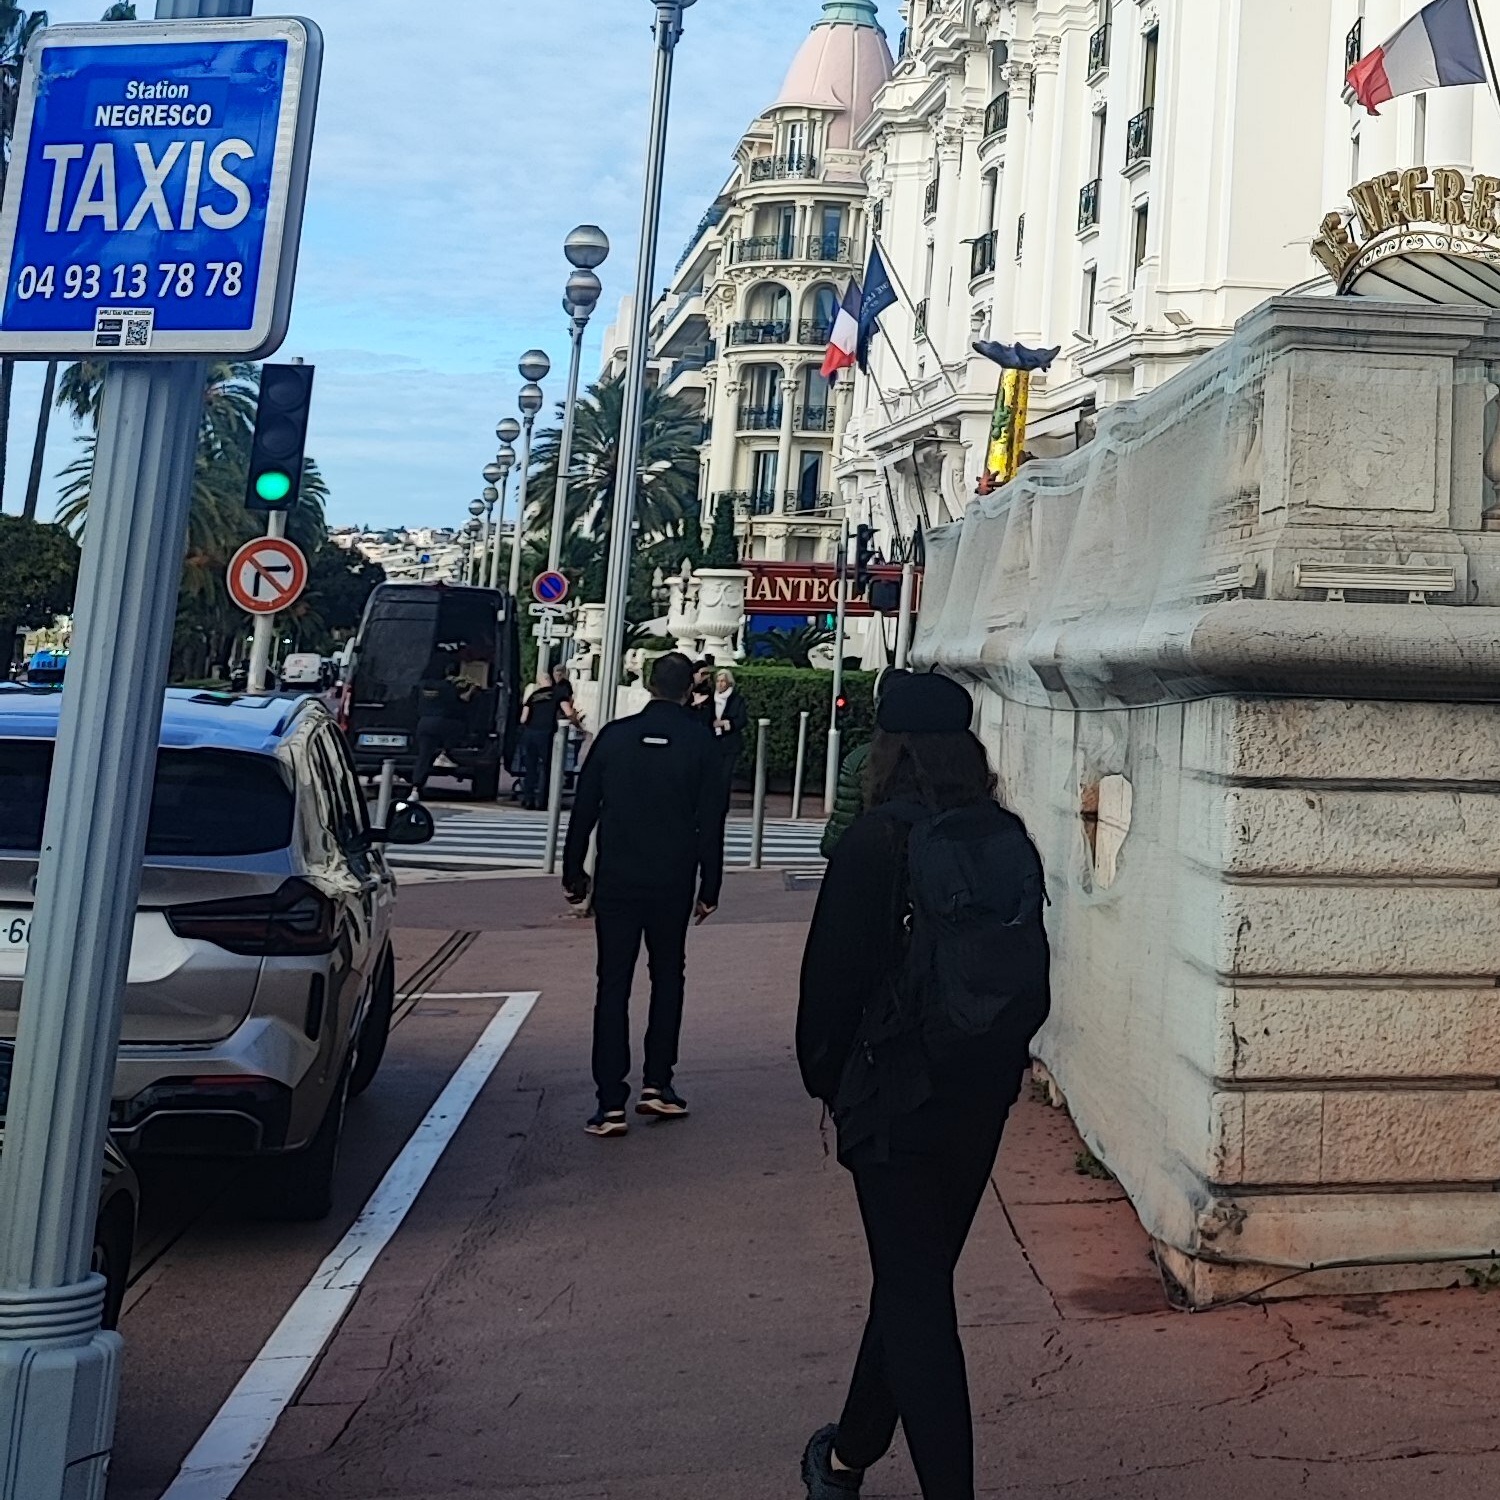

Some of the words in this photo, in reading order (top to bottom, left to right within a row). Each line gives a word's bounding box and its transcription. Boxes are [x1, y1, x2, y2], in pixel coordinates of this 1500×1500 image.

[126, 80, 189, 99] Station
[94, 104, 212, 127] NEGRESCO
[42, 138, 255, 233] TAXIS
[17, 265, 54, 299] 04
[63, 264, 100, 299] 93
[111, 263, 146, 298] 13
[158, 263, 195, 297] 78
[205, 262, 243, 296] 78
